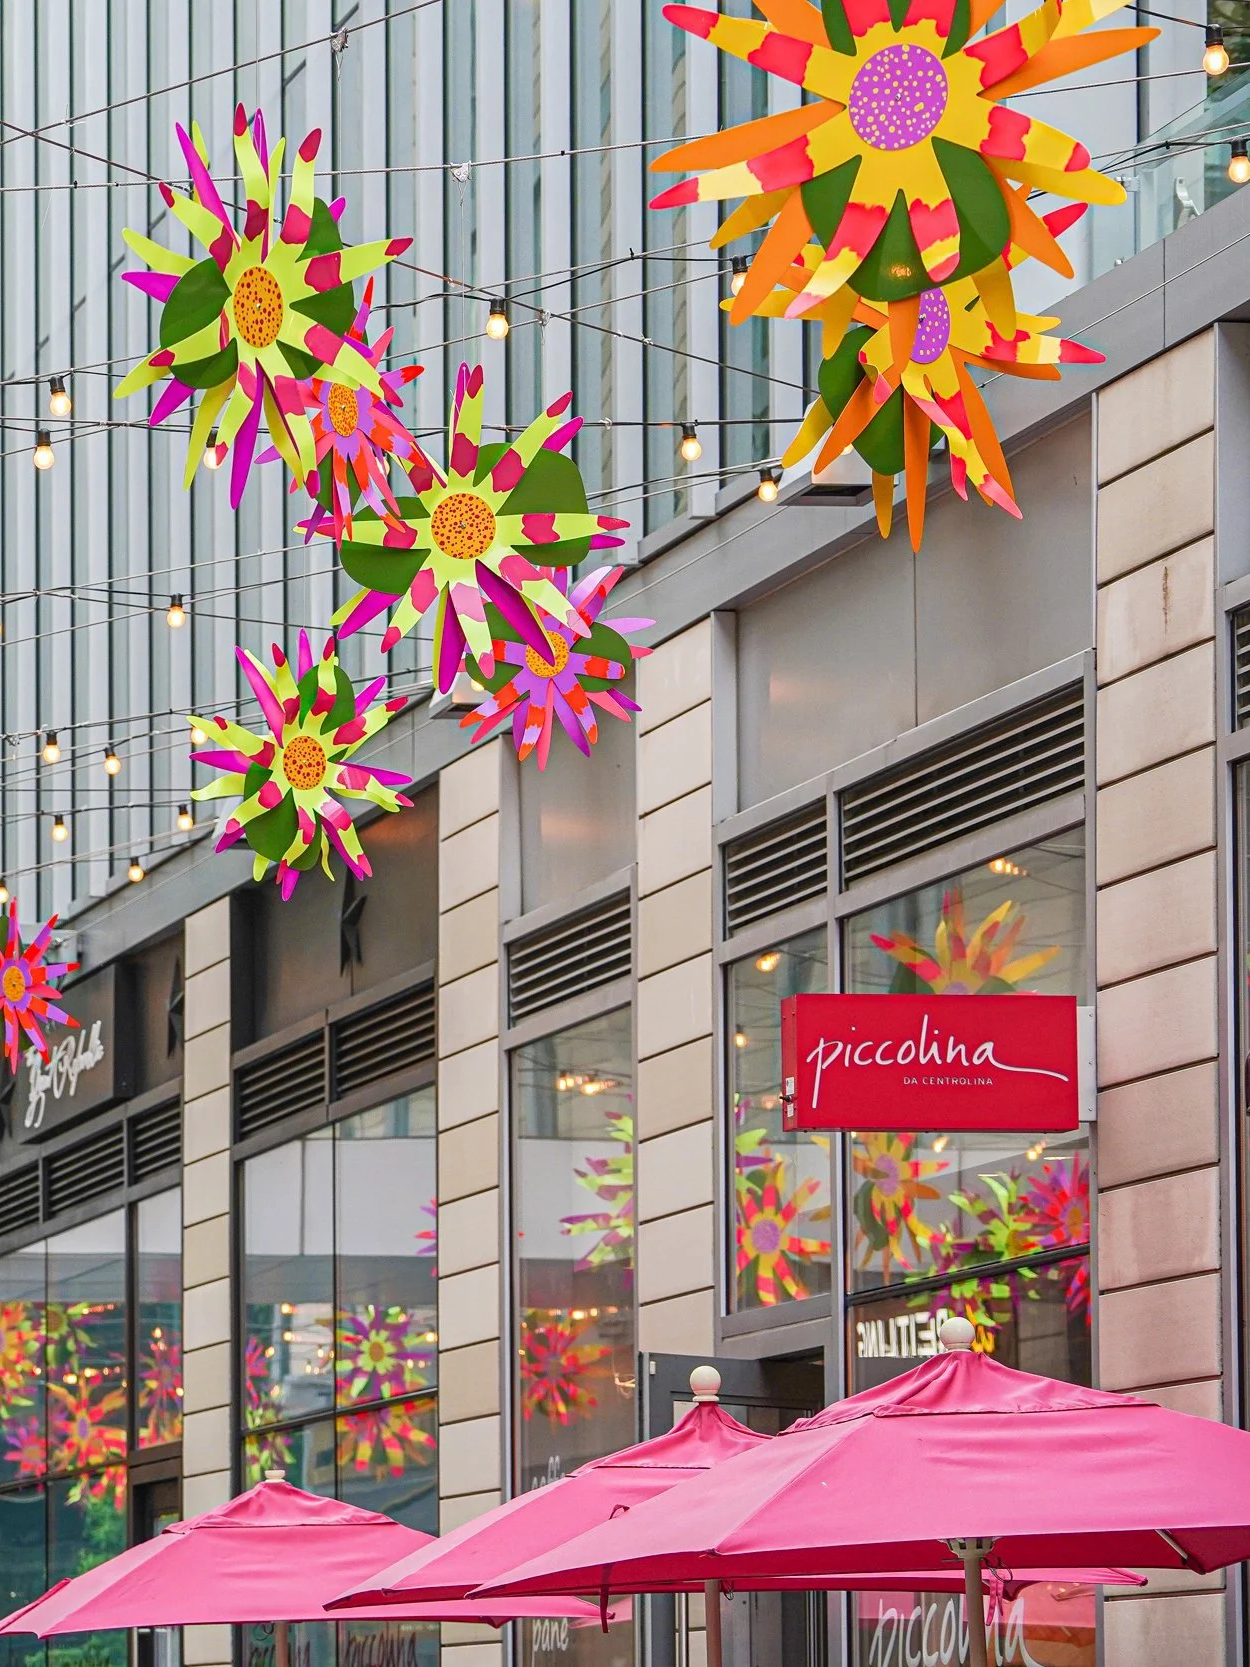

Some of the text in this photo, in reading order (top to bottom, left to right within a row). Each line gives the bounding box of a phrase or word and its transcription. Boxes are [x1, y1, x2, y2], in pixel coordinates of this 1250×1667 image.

[806, 1014, 1069, 1109] piccolina
[903, 1076, 994, 1086] DA CENTROLINA
[869, 1594, 1046, 1667] piccolna
